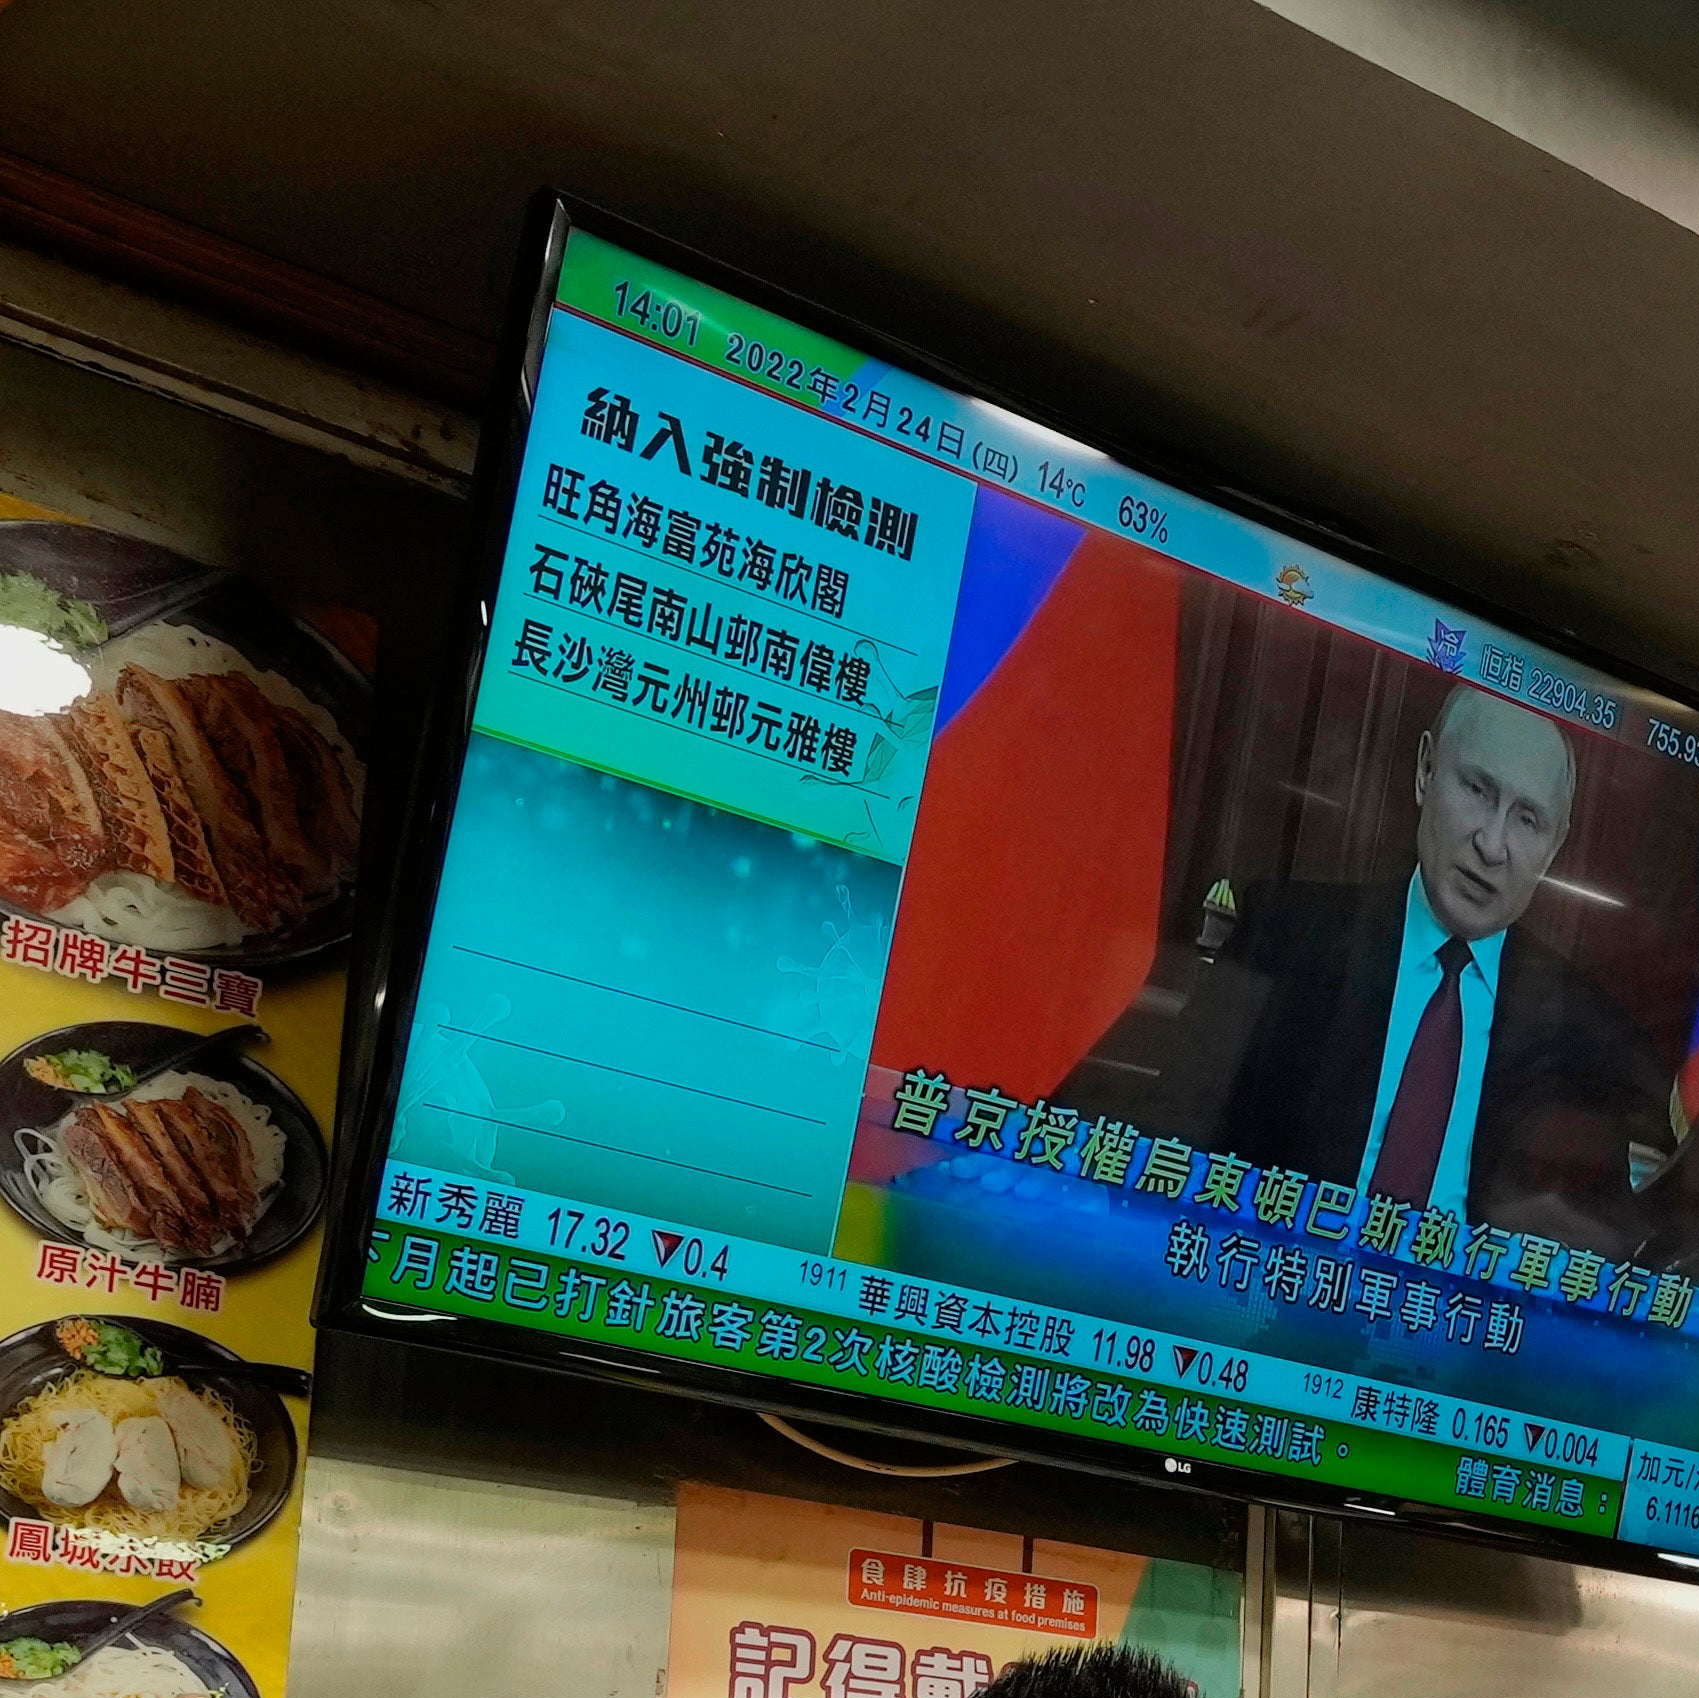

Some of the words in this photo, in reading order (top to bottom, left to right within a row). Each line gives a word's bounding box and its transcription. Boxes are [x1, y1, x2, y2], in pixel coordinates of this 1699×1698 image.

[580, 385, 919, 563] 納入強制檢測
[611, 279, 704, 350] 14:01
[1117, 492, 1170, 545] 63%
[541, 463, 849, 621] 旺角海富苑海欣閣
[512, 617, 857, 778] 長沙灣元州邨元雅樓
[527, 542, 870, 708] 石硤尾南山邨南偉樓
[1479, 643, 1524, 692] 恒指
[1528, 667, 1617, 730] 22904.35
[6, 919, 259, 1018] 招牌牛三寶
[37, 1244, 223, 1312] 原汁牛腩
[892, 1069, 1695, 1331] 普京授權烏東頓巴斯執行軍事行動
[389, 1172, 525, 1240] 新秀麗
[547, 1206, 630, 1263] 17.32
[798, 1259, 848, 1292] 1911
[858, 1273, 1076, 1356] 華興資本控股
[1091, 1327, 1156, 1375] 11.98
[1302, 1370, 1343, 1400] 1912
[1350, 1387, 1441, 1436] 康特隆
[1451, 1411, 1510, 1448] 0.165
[1166, 1219, 1527, 1357] 執行特別軍事行動
[861, 1558, 1085, 1616] 食肆抗疫措施
[861, 1588, 939, 1611] Anti-epidemic
[942, 1603, 995, 1619] measures
[997, 1609, 1009, 1621] at
[1011, 1610, 1036, 1625] food
[1037, 1616, 1085, 1632] premises
